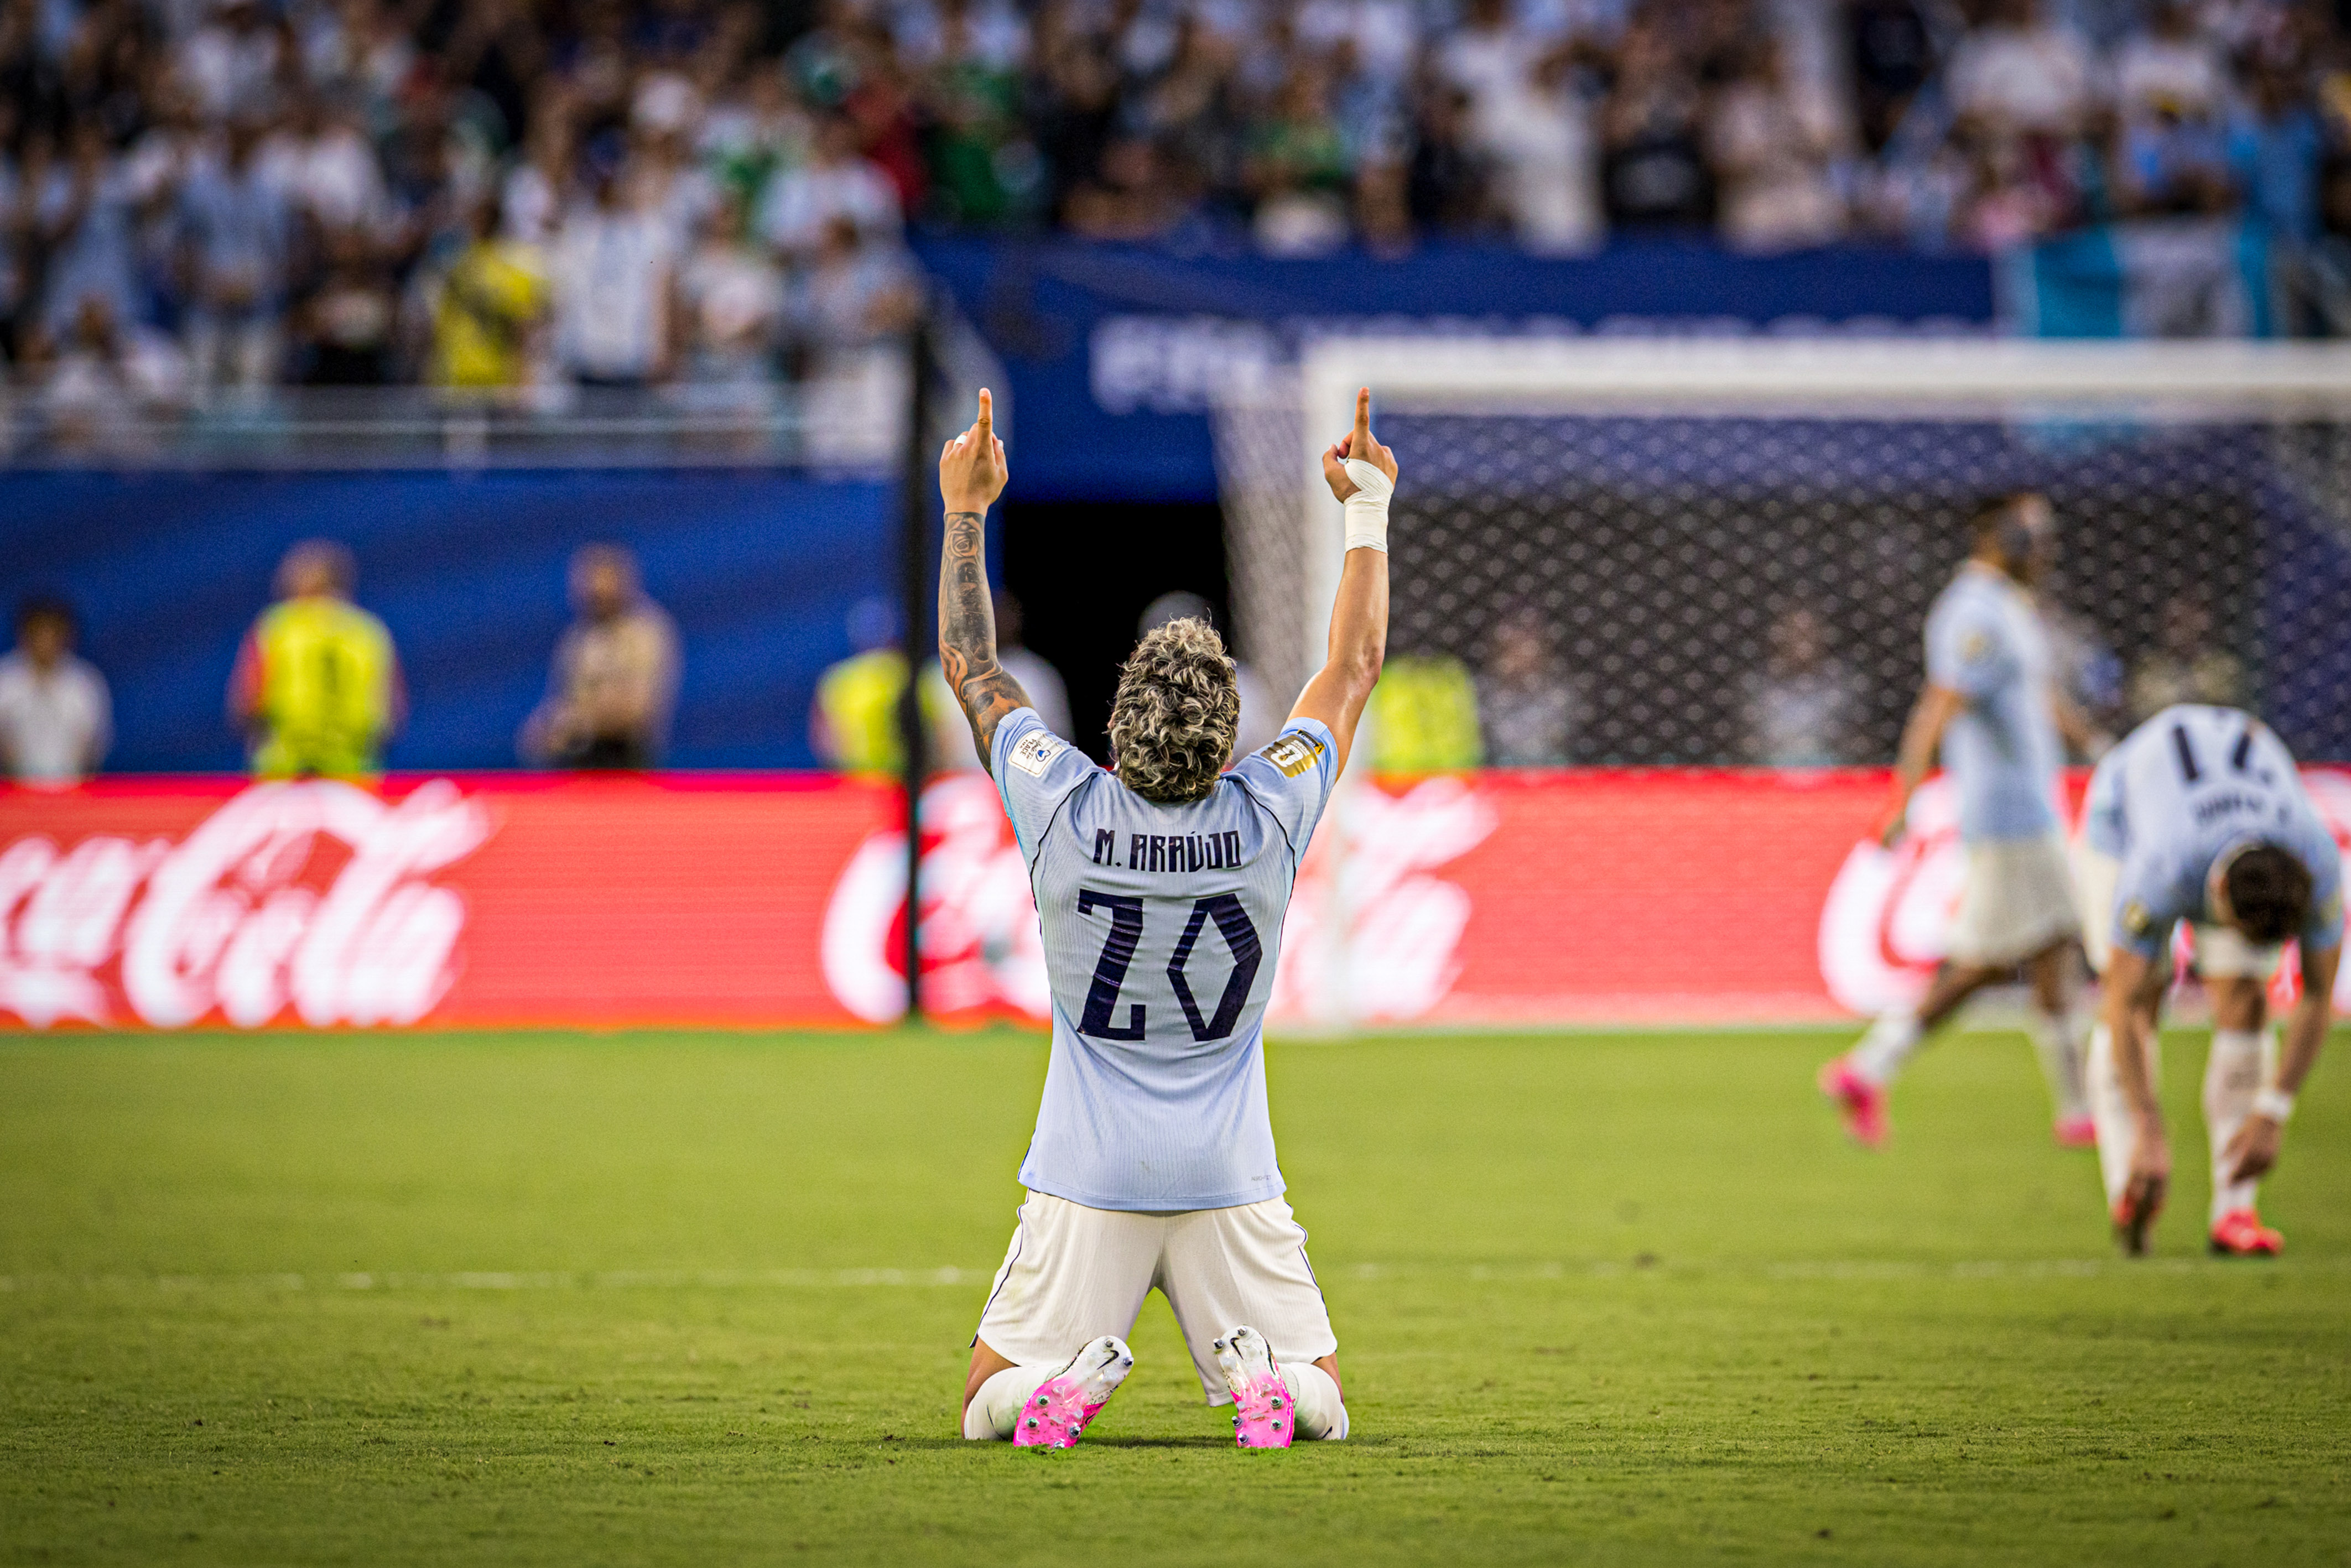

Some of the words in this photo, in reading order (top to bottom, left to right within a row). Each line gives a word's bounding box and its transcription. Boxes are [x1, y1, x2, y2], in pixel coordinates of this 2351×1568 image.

[1020, 738, 1037, 756] PEACE
[1093, 829, 1122, 866] M.
[1129, 831, 1241, 872] ARAÚJO
[1076, 888, 1262, 1041] 20
